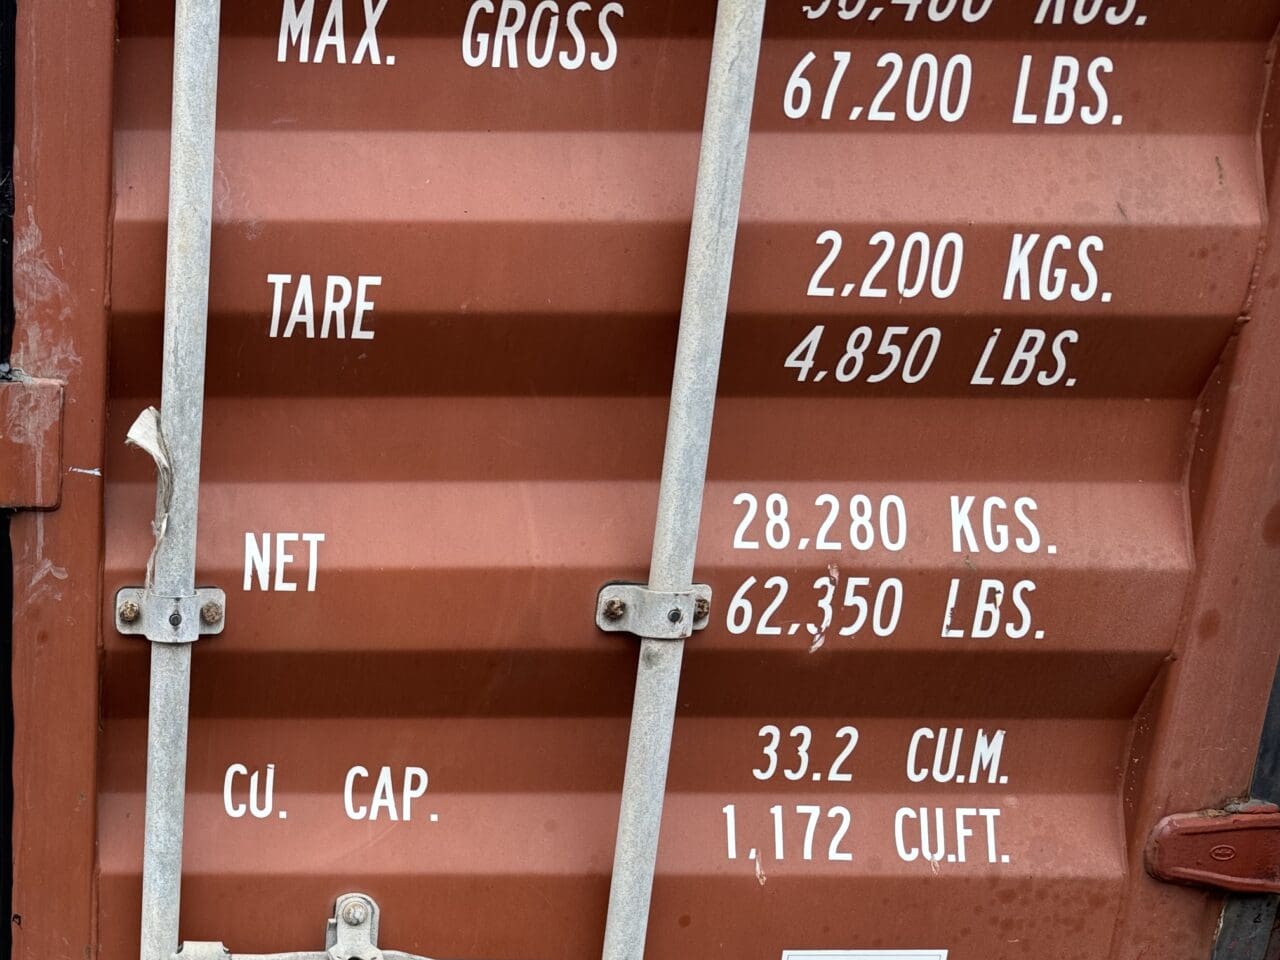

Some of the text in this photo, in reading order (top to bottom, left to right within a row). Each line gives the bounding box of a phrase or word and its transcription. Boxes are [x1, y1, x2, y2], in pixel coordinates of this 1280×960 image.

[277, 0, 624, 71] MAX. GROSS
[783, 51, 1123, 126] 67,200 LBS.
[807, 231, 1114, 303] 2,200 KGS.
[266, 273, 382, 340] TARE
[783, 326, 1078, 388] 4,850 LBS.
[732, 493, 1058, 555] 28,280 KGS.
[243, 532, 325, 593] NET
[725, 576, 1046, 640] 62,350 LBS.
[752, 726, 1009, 785] 33.2 CU.M.
[223, 764, 438, 822] CU. CAP.
[722, 805, 1010, 863] 1,172 CU.FT.
